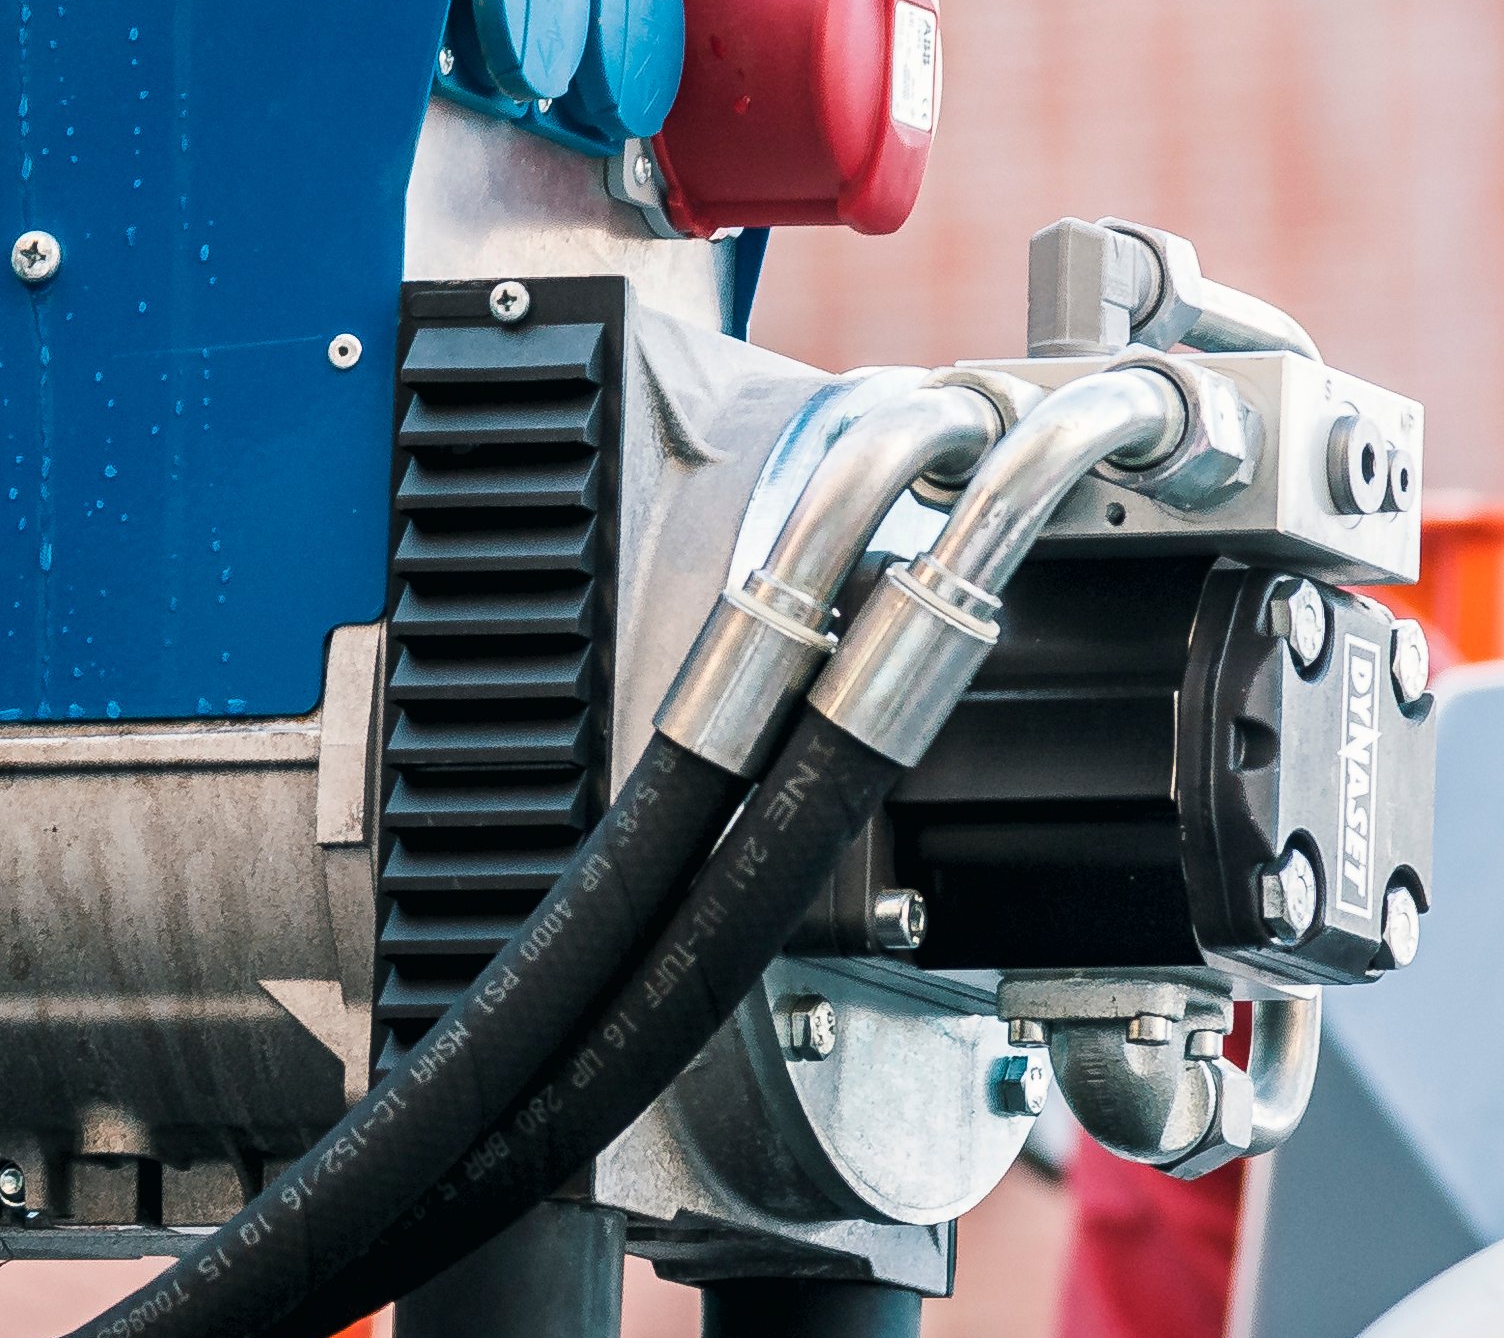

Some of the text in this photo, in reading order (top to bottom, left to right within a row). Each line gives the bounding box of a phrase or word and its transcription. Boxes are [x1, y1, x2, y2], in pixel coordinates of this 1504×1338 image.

[1337, 655, 1382, 898] DYNASET
[519, 898, 575, 964] 4000
[197, 1246, 232, 1282] 15
